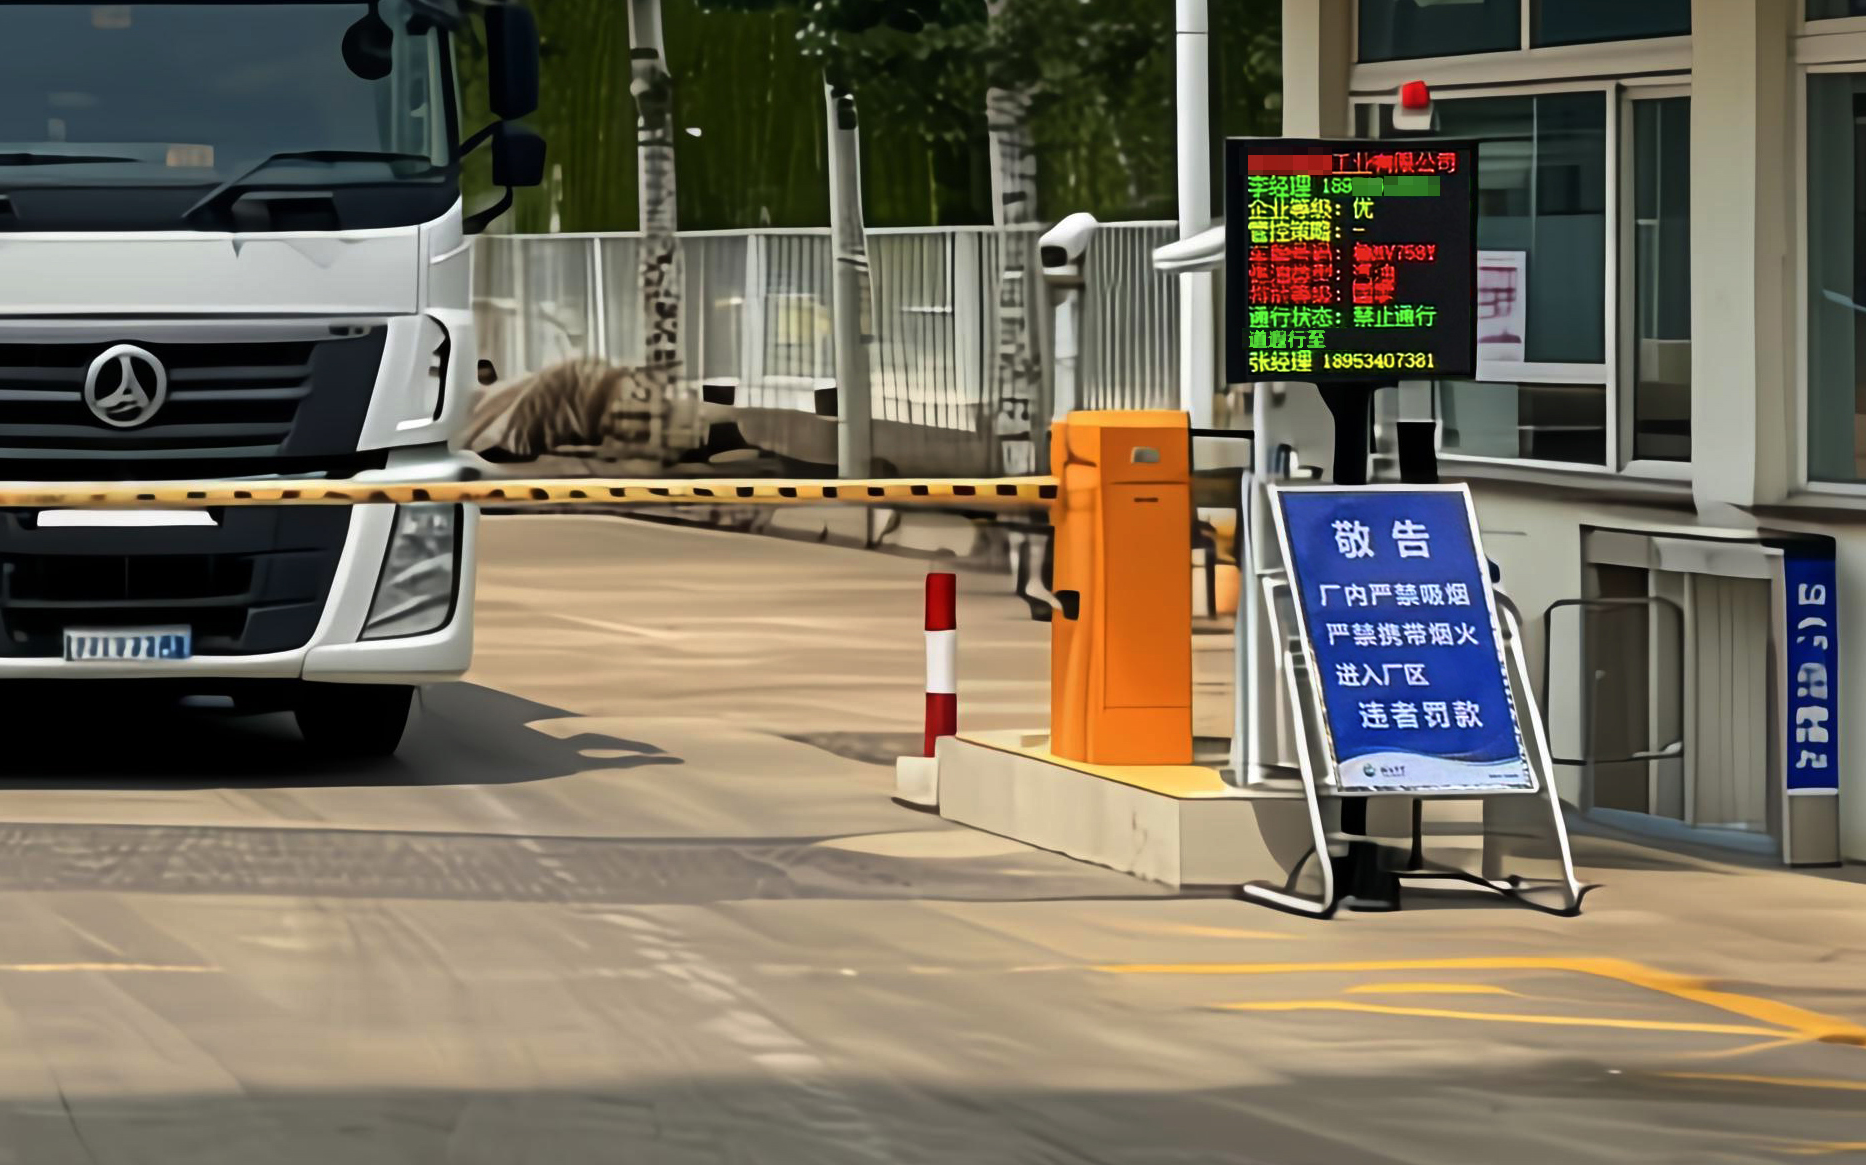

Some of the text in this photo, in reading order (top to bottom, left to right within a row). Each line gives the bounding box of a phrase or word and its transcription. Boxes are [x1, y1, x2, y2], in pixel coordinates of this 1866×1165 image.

[1249, 350, 1434, 372] 张经理 18953407381
[1331, 520, 1431, 559] 敬告
[1319, 583, 1471, 607] 厂内严禁吸烟
[1326, 622, 1480, 647] 严禁携带烟火
[1336, 663, 1430, 687] 进入厂区
[1358, 700, 1483, 729] 违者罚款
